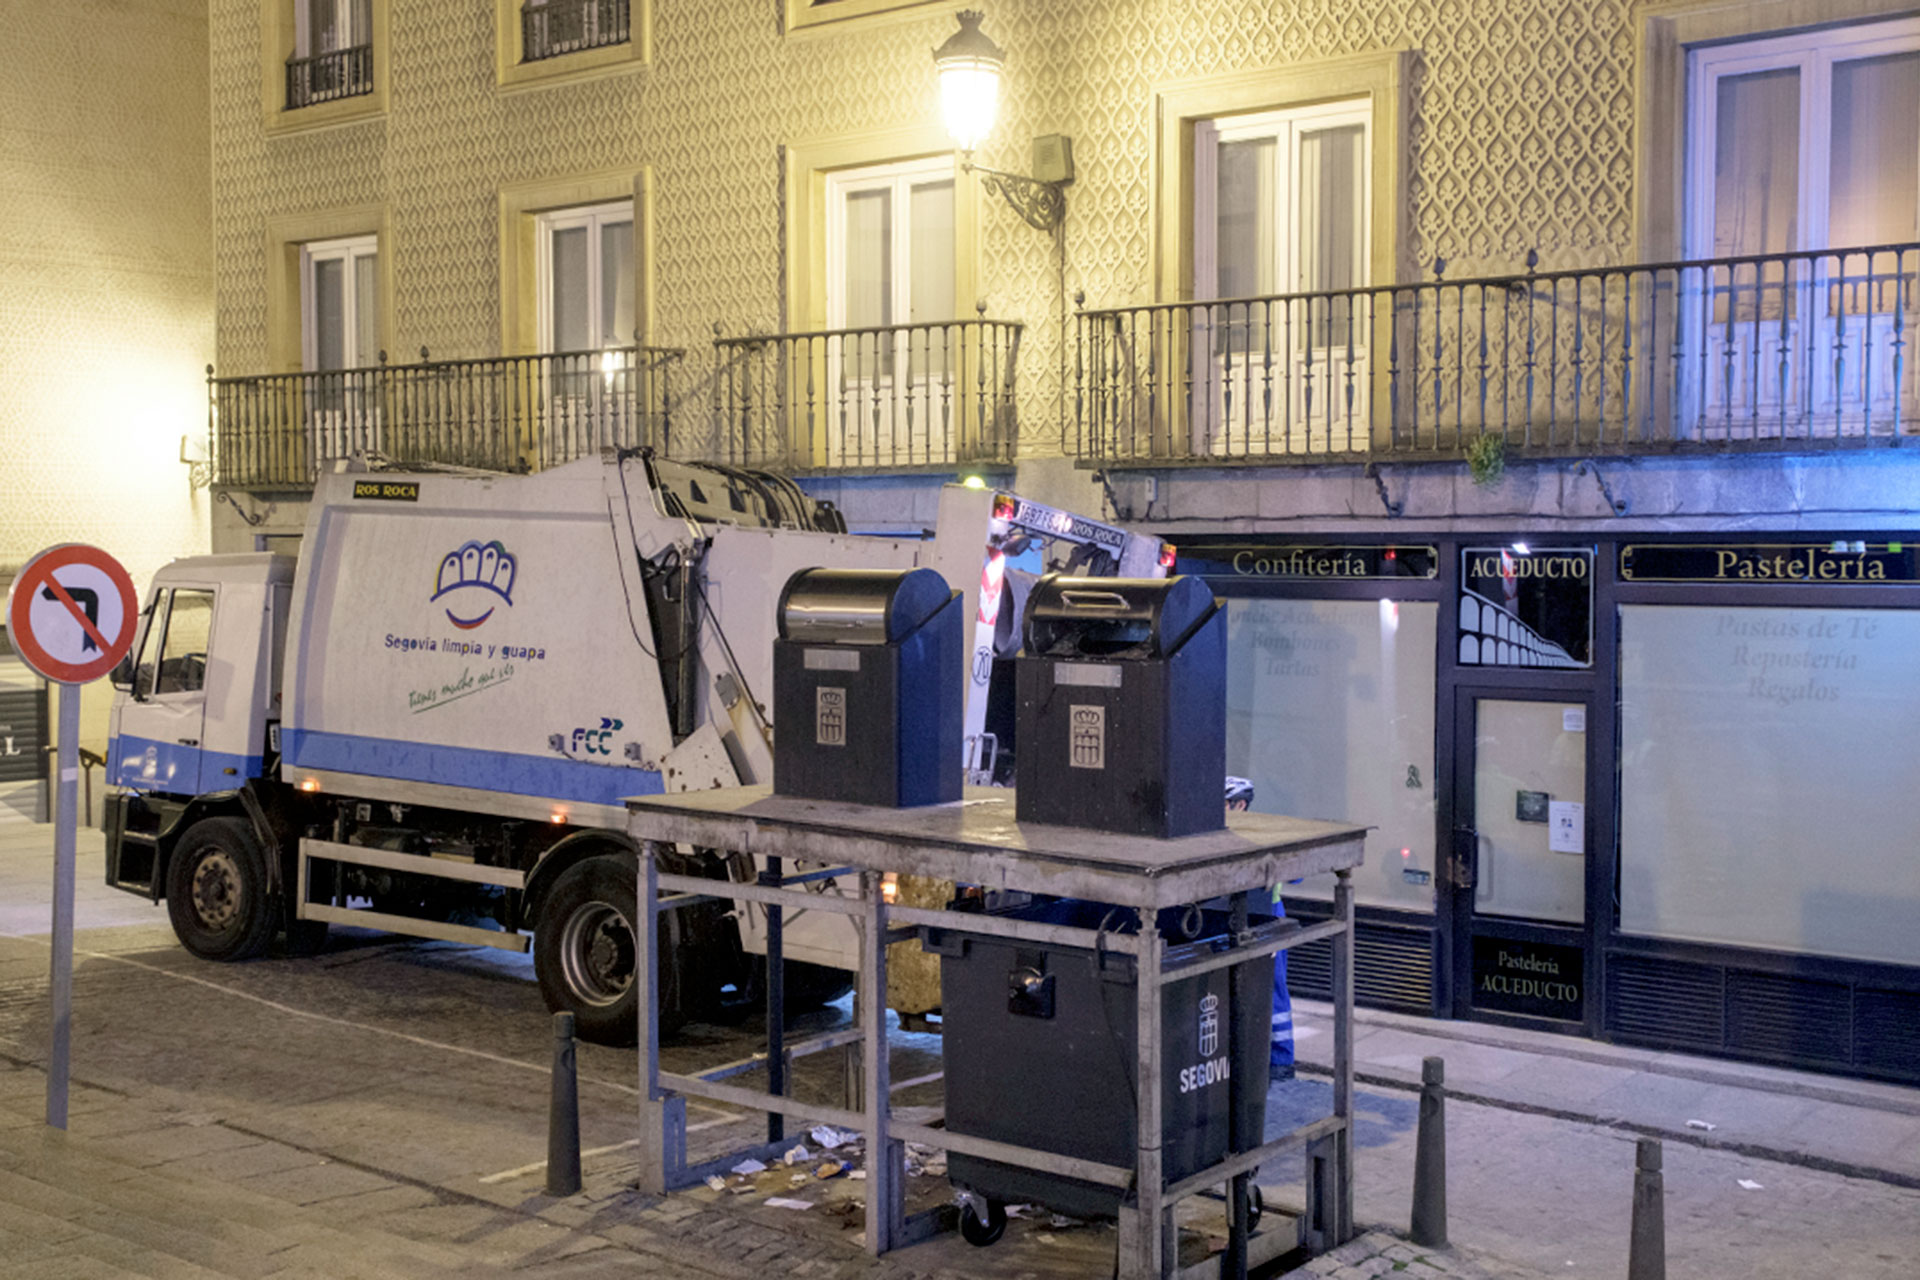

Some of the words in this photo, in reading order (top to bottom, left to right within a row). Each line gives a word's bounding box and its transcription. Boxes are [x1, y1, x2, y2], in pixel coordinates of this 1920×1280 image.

[355, 484, 379, 496] ROS
[383, 485, 416, 498] ROCA
[1072, 522, 1094, 539] ROS
[1095, 529, 1122, 545] ROCA
[1233, 550, 1366, 576] Confitería
[1470, 557, 1586, 578] ACUEDUCTO
[1715, 548, 1886, 579] Pastelería
[1716, 614, 1800, 638] Pastas
[1807, 614, 1839, 639] de
[1847, 616, 1878, 640] Té
[384, 633, 437, 652] Segovia
[442, 638, 483, 656] limpia
[488, 644, 496, 659] y
[501, 645, 546, 661] guapa
[1250, 630, 1341, 651] Bombones
[1265, 657, 1320, 678] Tartas
[1730, 645, 1857, 674] Repostería
[1748, 676, 1839, 708] Regalos
[572, 728, 613, 755] FCC
[1498, 951, 1560, 975] Pastelería
[1481, 975, 1578, 1002] ACUEDUCTO
